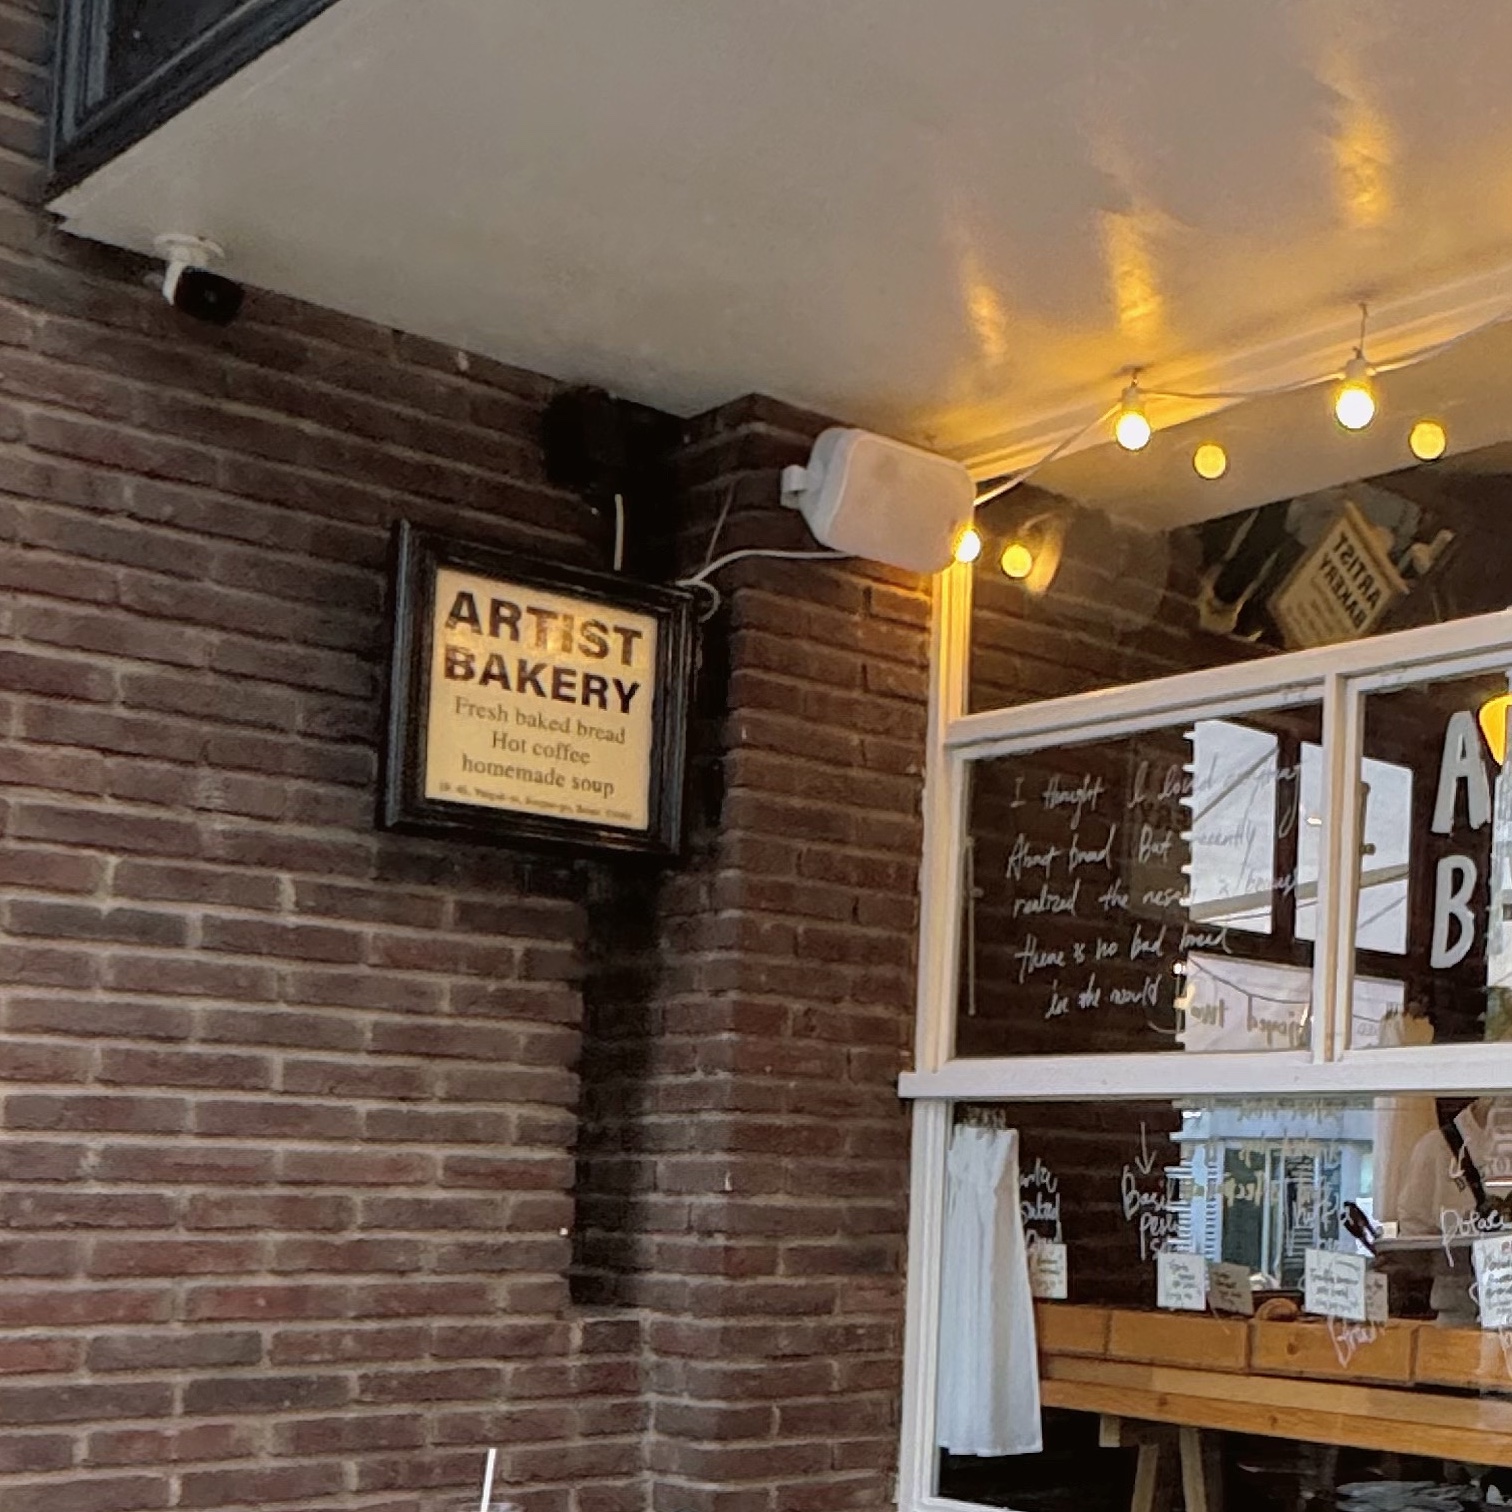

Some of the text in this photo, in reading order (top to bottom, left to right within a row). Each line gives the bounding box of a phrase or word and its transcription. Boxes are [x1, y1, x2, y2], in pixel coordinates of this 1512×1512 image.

[444, 590, 644, 667] ARTIST
[443, 644, 642, 715] BAKERY
[455, 695, 627, 746] Fresh baked bread
[492, 730, 591, 765] Hot coffee
[461, 752, 615, 800] homemade soup
